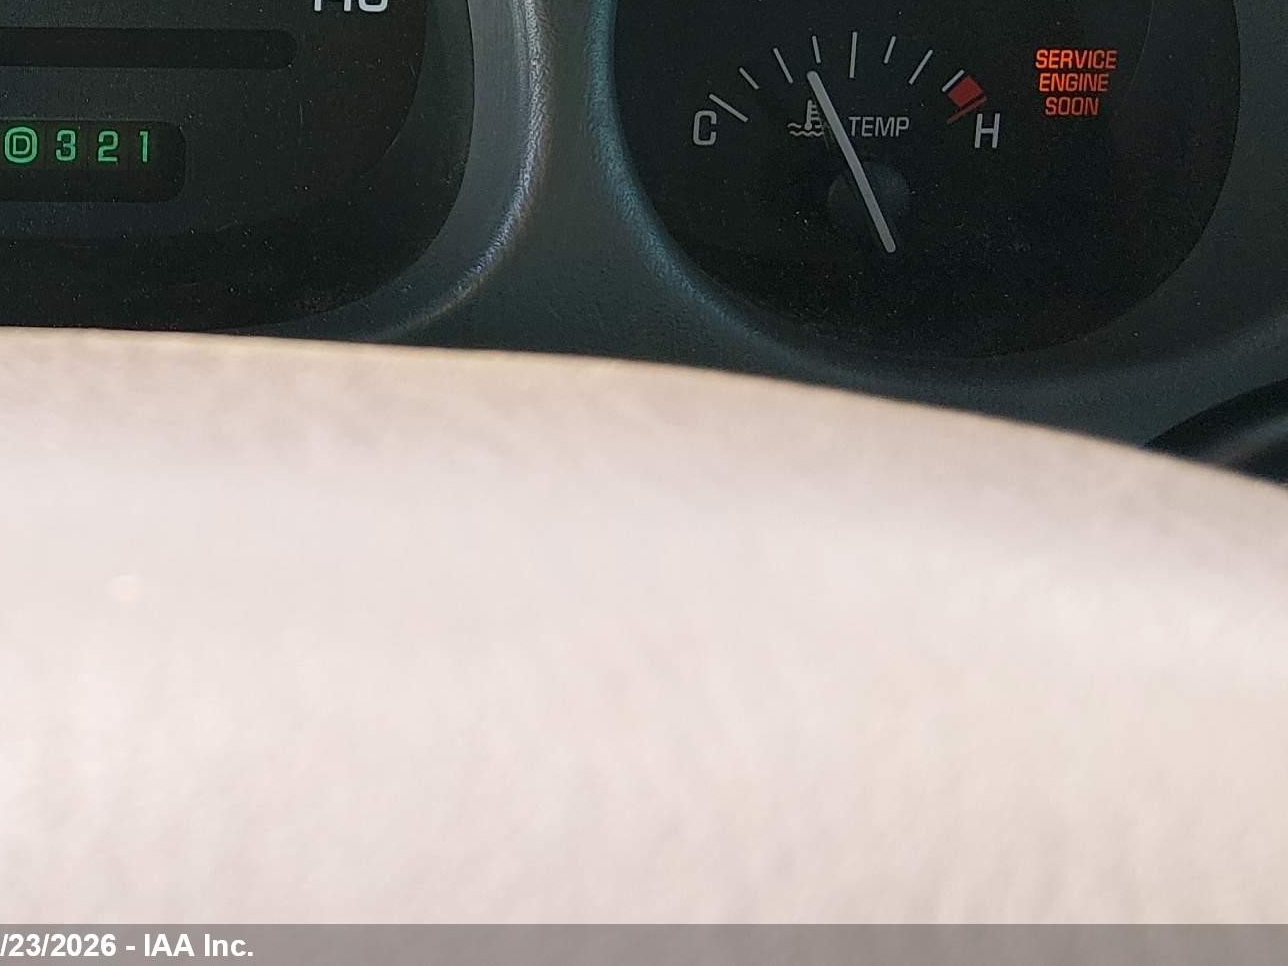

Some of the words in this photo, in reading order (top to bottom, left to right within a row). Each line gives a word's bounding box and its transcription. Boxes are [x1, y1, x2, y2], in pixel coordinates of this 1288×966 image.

[1035, 48, 1117, 70] SERVICE
[1038, 73, 1109, 93] ENGINE
[1044, 97, 1099, 117] SOON
[693, 110, 717, 146] C
[848, 116, 910, 138] TEMP
[974, 114, 1001, 149] H
[55, 130, 77, 162] 3
[98, 131, 119, 162] 2
[139, 131, 150, 162] 1
